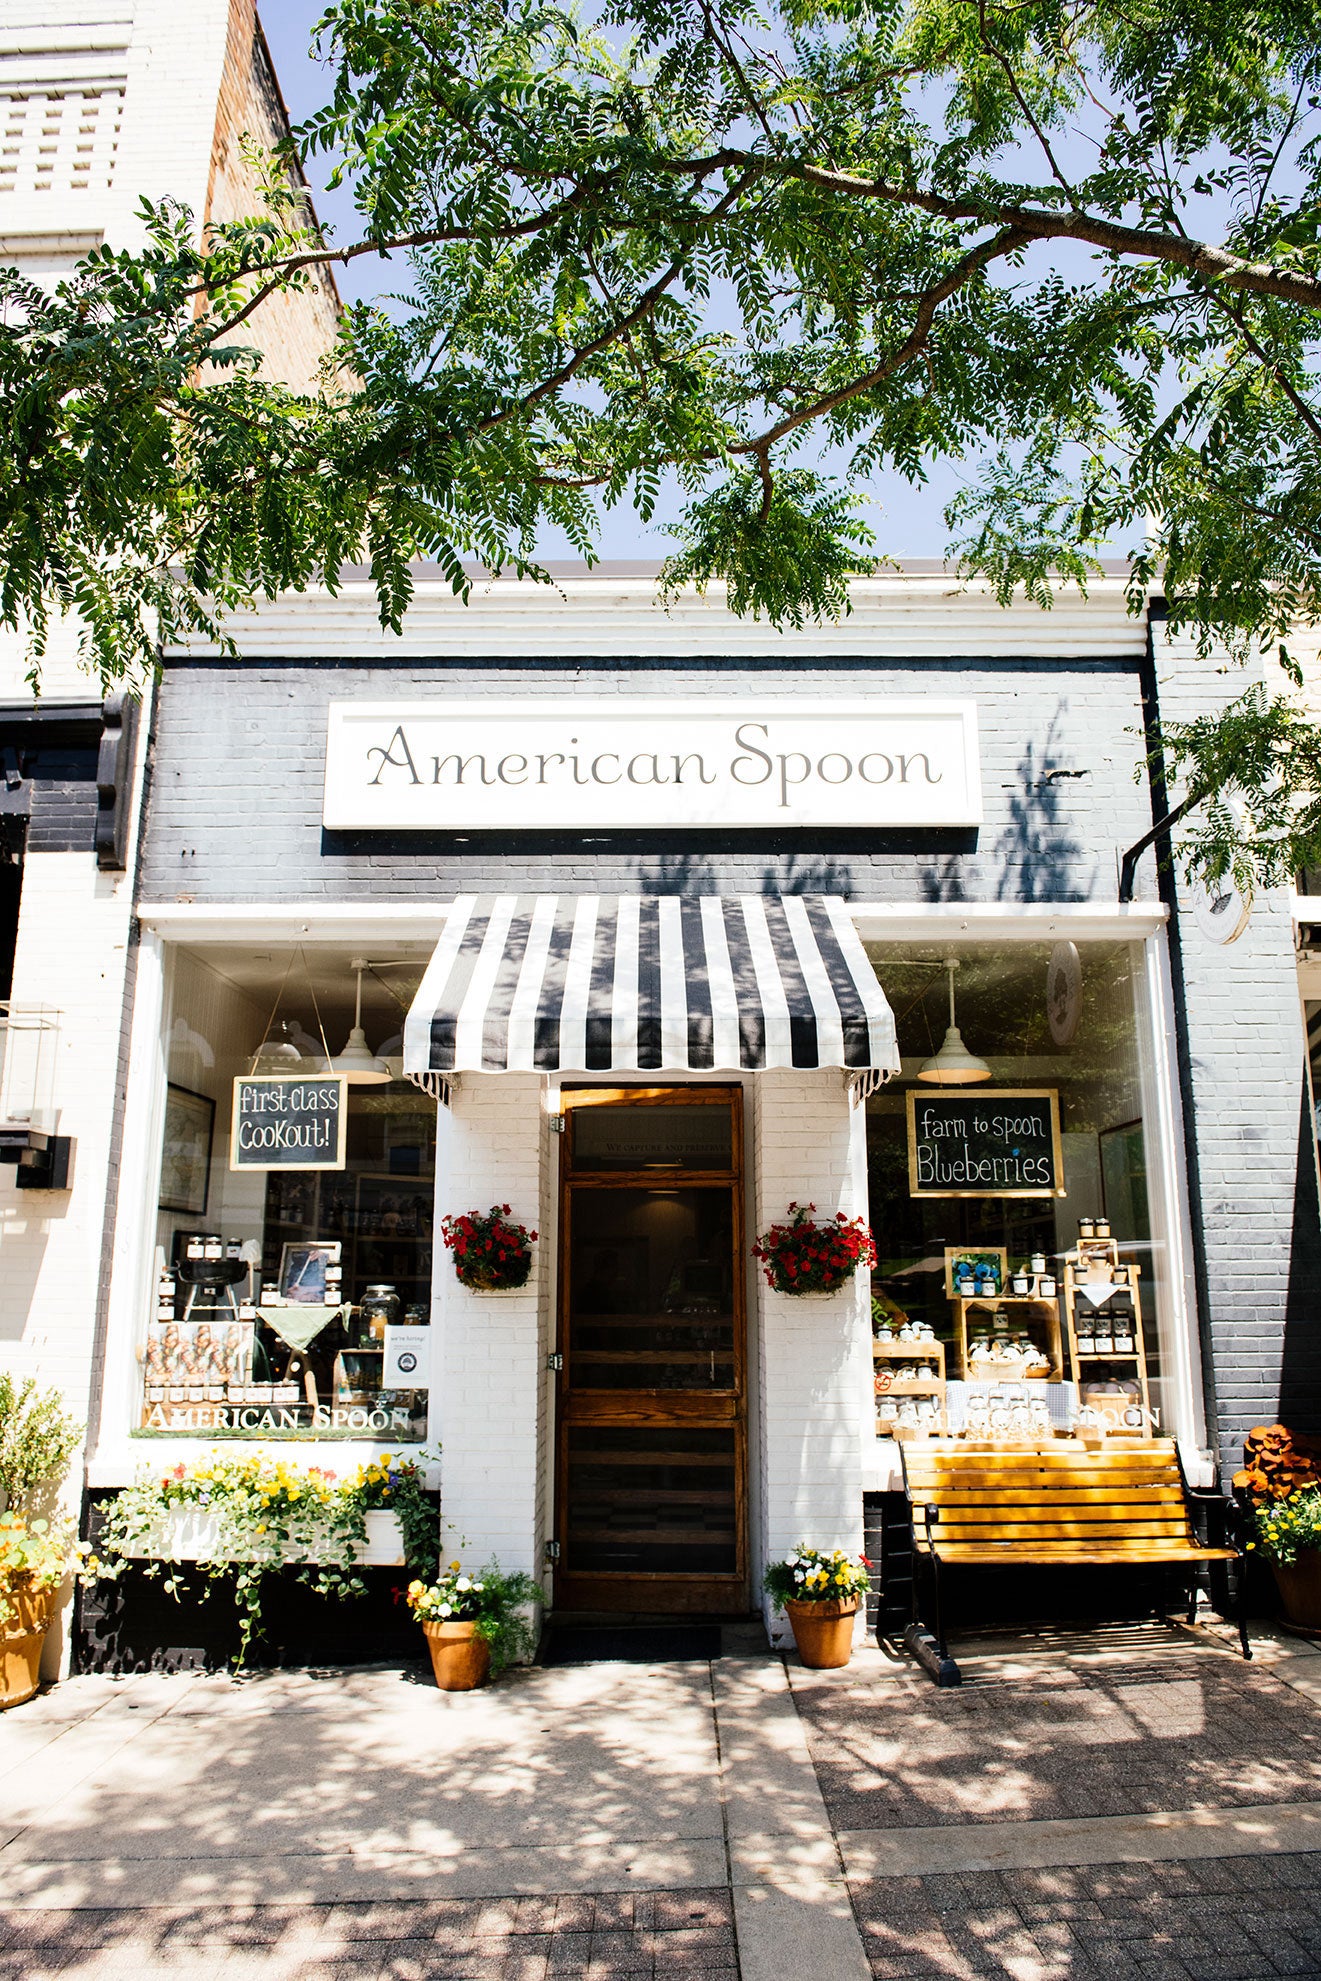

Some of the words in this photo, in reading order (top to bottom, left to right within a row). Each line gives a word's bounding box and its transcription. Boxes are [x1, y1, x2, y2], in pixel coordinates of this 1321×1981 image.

[366, 725, 717, 787] American
[729, 723, 943, 808] Spoon
[921, 1109, 968, 1139] farm
[973, 1116, 989, 1133] to
[992, 1115, 1047, 1144] spoon
[623, 1144, 662, 1152] CAPTURE
[665, 1144, 684, 1152] AND
[685, 1144, 726, 1152] PRESERVE
[917, 1143, 1051, 1184] Blueberries
[145, 1403, 300, 1431] AMERICAN
[313, 1404, 410, 1431] SPOON
